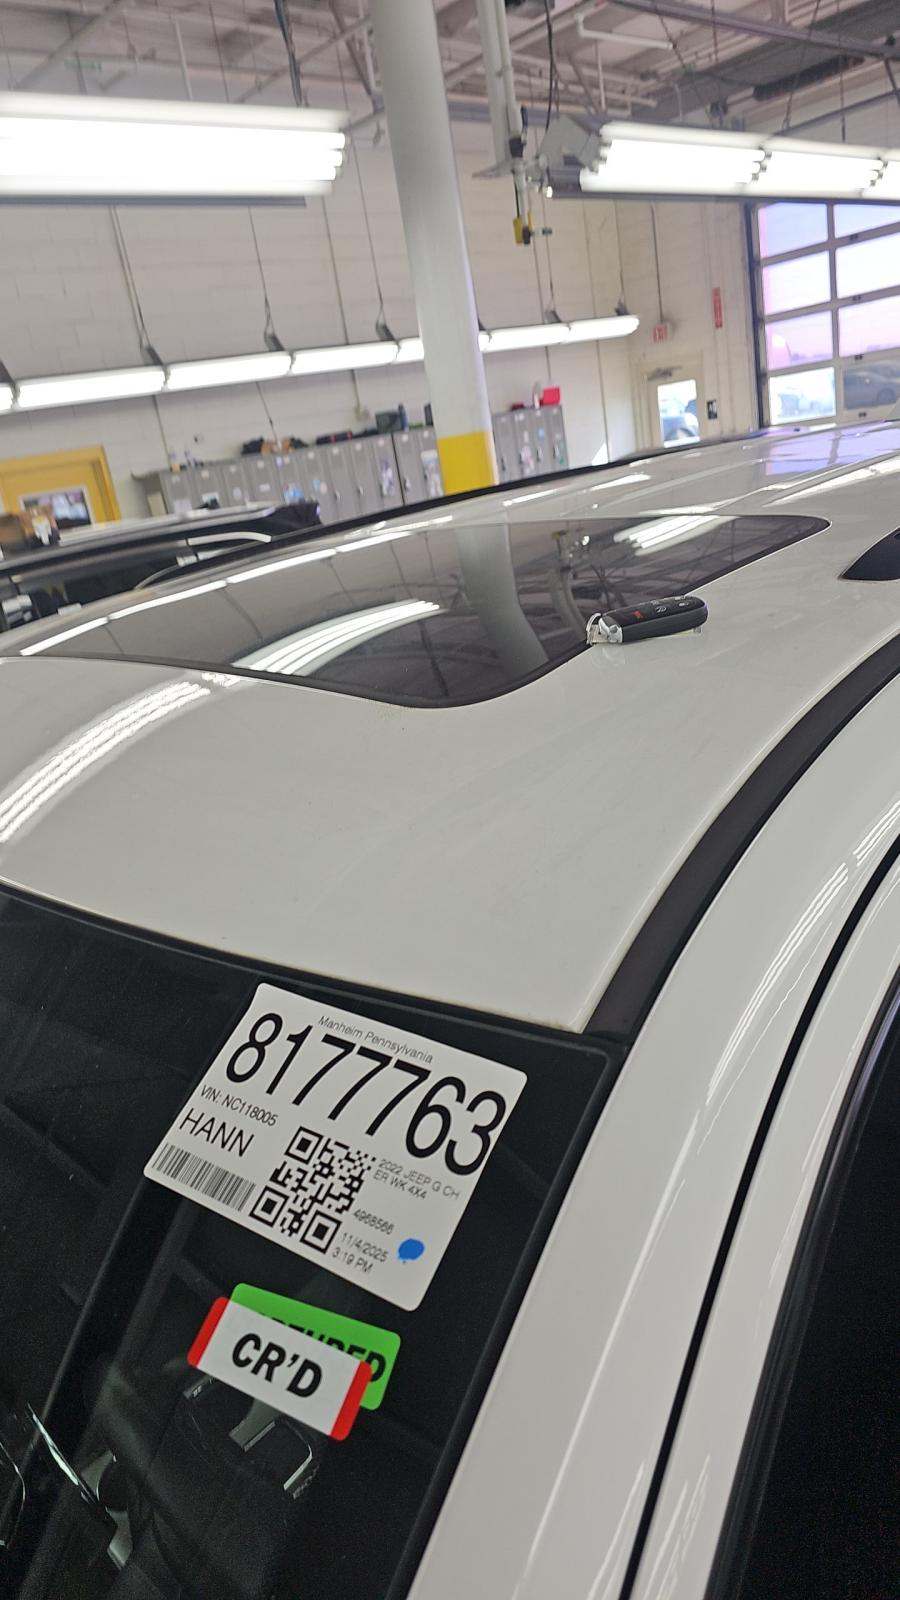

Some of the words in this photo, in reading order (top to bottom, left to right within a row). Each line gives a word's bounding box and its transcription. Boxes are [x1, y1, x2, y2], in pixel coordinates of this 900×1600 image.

[318, 1016, 363, 1039] Manheim
[364, 1031, 433, 1064] Pennsylvania
[200, 1084, 221, 1103] VIN:
[222, 1093, 278, 1126] NC118005
[225, 1012, 507, 1176] 8177763
[178, 1107, 255, 1158] HANN
[374, 1170, 388, 1183] ER
[391, 1176, 407, 1191] WK
[378, 1159, 404, 1176] 2022
[404, 1170, 431, 1187] JEEP
[442, 1186, 461, 1200] CH
[342, 1232, 389, 1262] 11/4/2025
[356, 1258, 374, 1273] PM
[232, 1333, 323, 1398] CR'D
